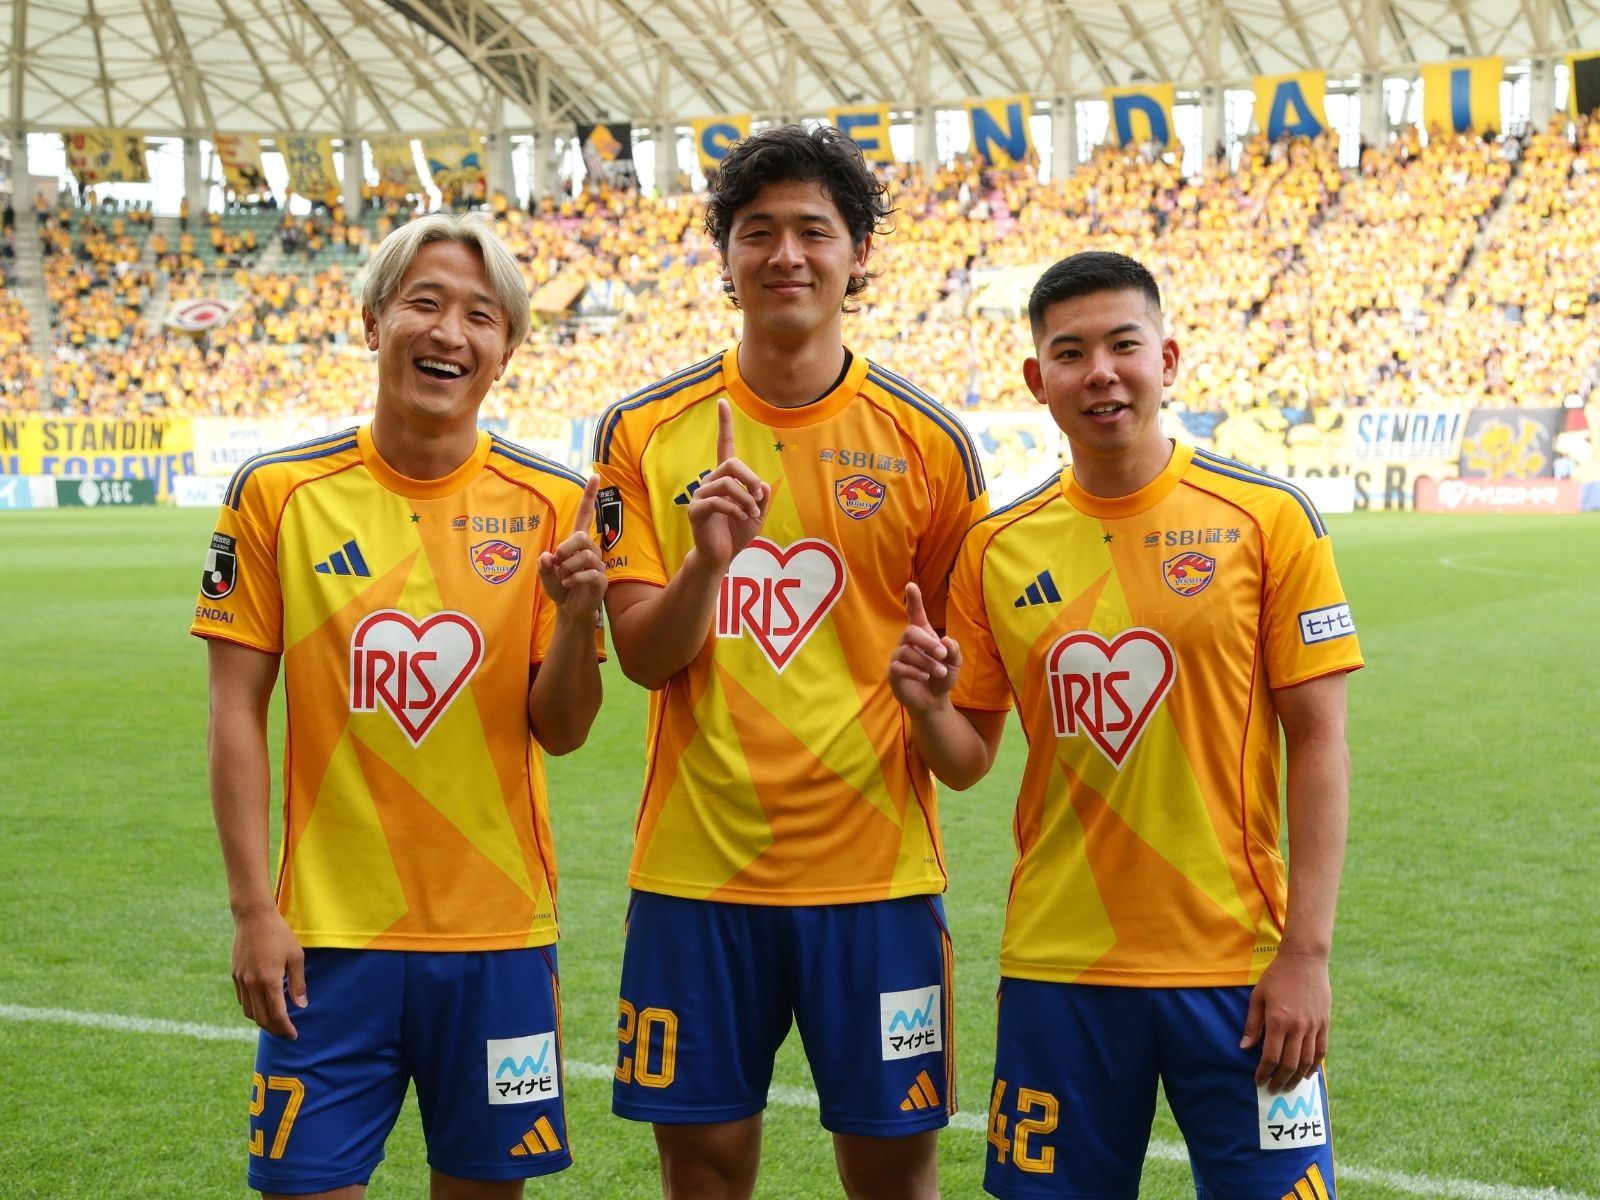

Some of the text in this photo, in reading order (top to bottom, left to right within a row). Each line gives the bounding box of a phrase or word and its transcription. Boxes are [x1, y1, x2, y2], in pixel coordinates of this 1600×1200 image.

[43, 421, 170, 450] STANDIN'
[100, 481, 134, 503] SGC
[472, 514, 541, 534] SBI証券
[1144, 535, 1159, 544] SBI
[1165, 527, 1241, 547] SBI証券
[1306, 612, 1354, 635] 七十七
[615, 997, 678, 1089] 20
[889, 1028, 936, 1052] マイナビ
[495, 1075, 552, 1097] マイナビ
[249, 1071, 305, 1160] 27
[987, 1079, 1060, 1174] 42
[1267, 1120, 1323, 1141] マイナビ
